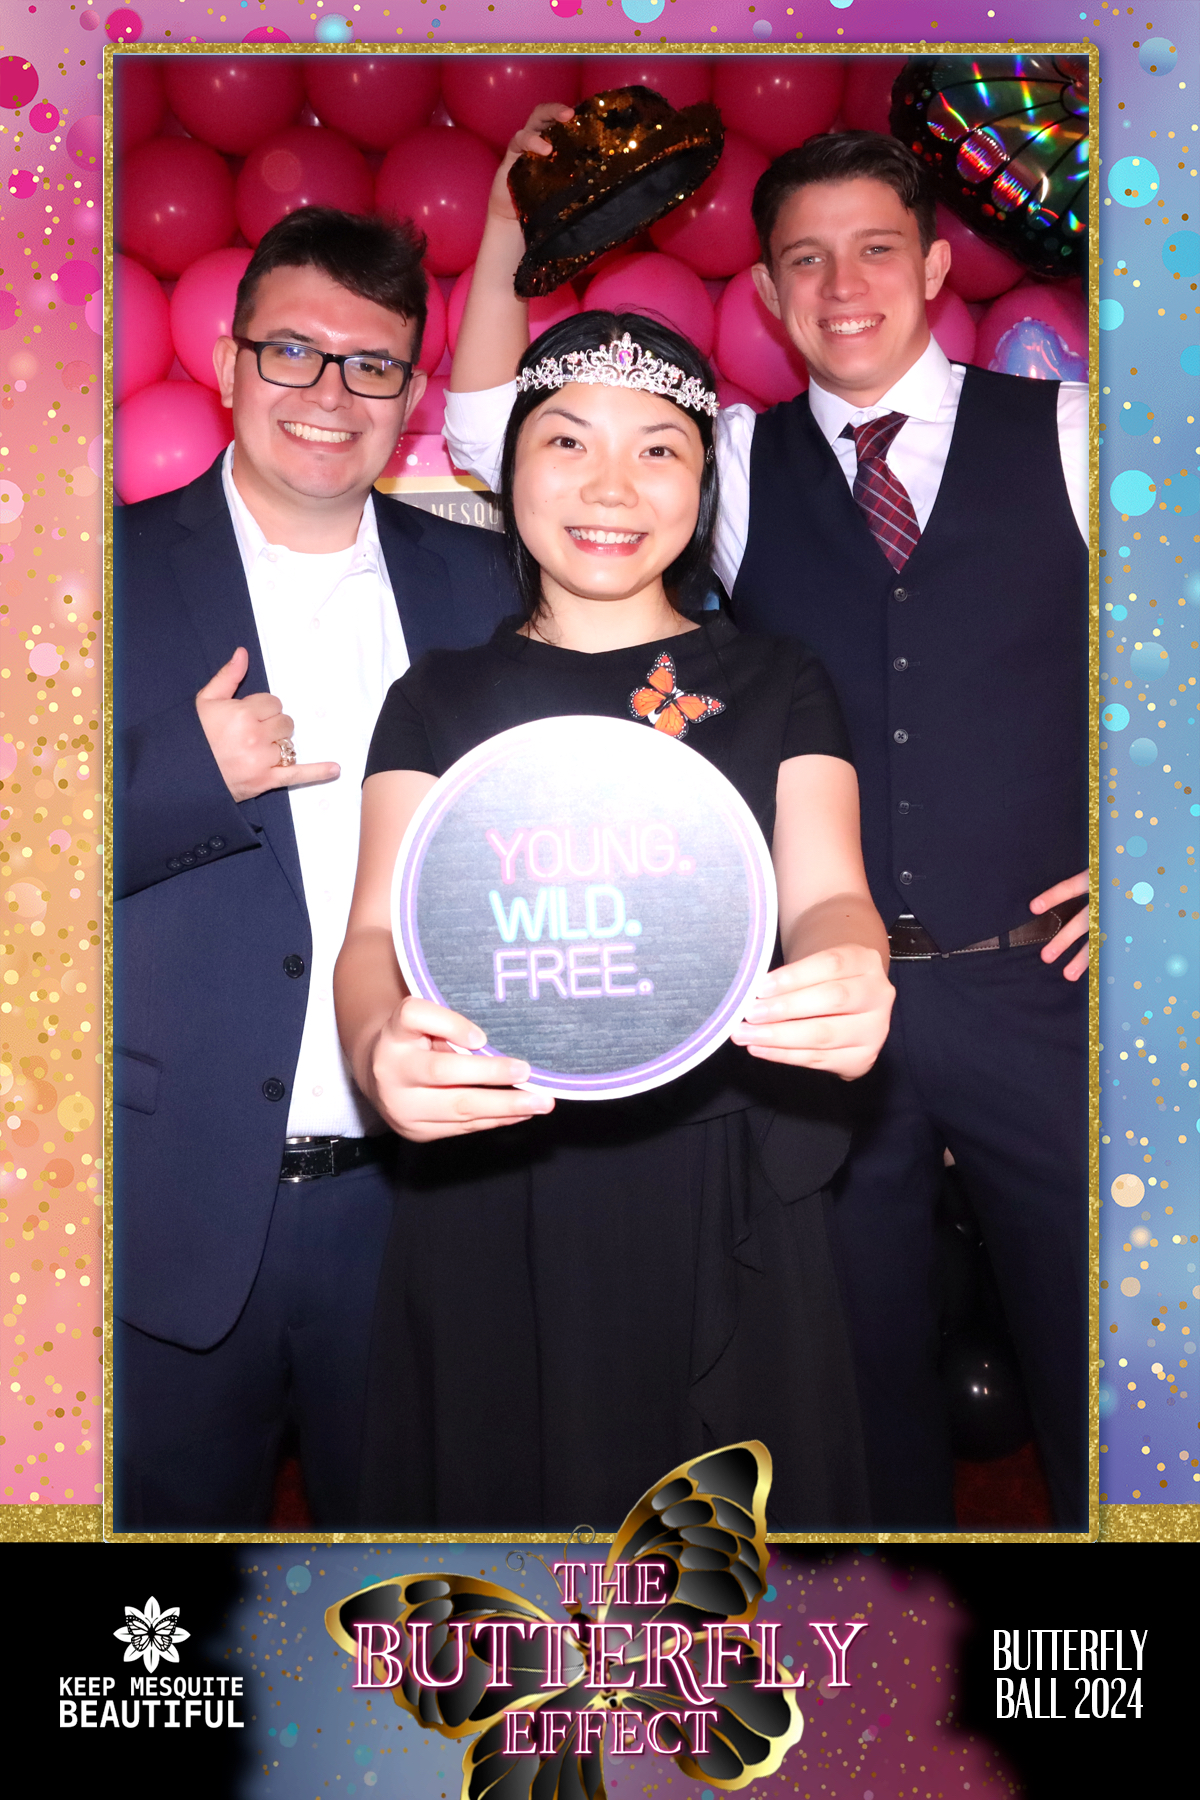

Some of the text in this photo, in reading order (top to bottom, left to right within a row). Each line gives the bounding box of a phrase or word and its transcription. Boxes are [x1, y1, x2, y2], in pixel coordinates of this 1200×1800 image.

[486, 823, 696, 884] YOUNG.
[489, 884, 642, 943] WILD.
[494, 944, 654, 1001] FREE.
